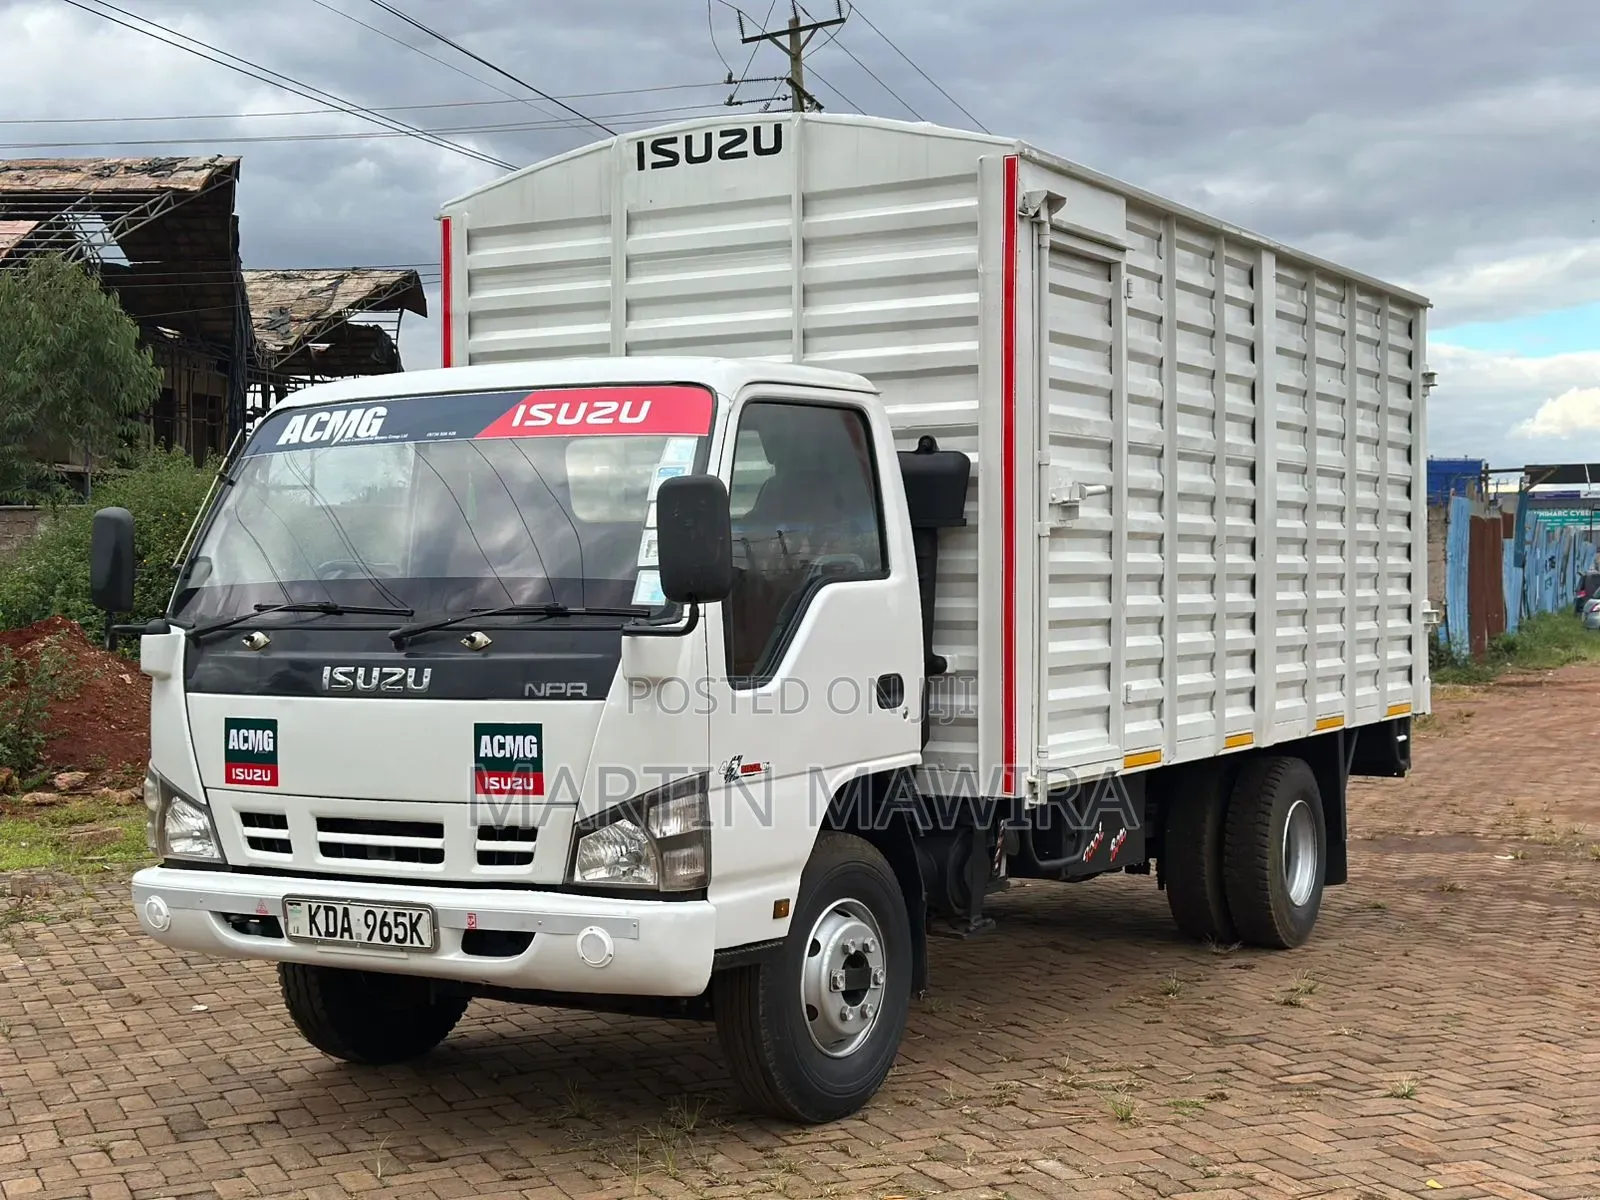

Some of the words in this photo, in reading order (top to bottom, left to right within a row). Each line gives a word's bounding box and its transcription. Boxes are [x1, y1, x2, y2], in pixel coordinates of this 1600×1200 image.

[636, 123, 782, 171] ISUZU
[276, 405, 388, 446] ACMG
[511, 400, 652, 428] ISUZU
[322, 666, 432, 692] ISUZU
[524, 682, 588, 697] NPR
[228, 728, 274, 754] ACMG
[479, 734, 538, 762] ACMG
[232, 768, 271, 781] ISUZU
[484, 776, 534, 790] ISUZU
[307, 903, 354, 940] KDA
[364, 910, 425, 946] 965K
